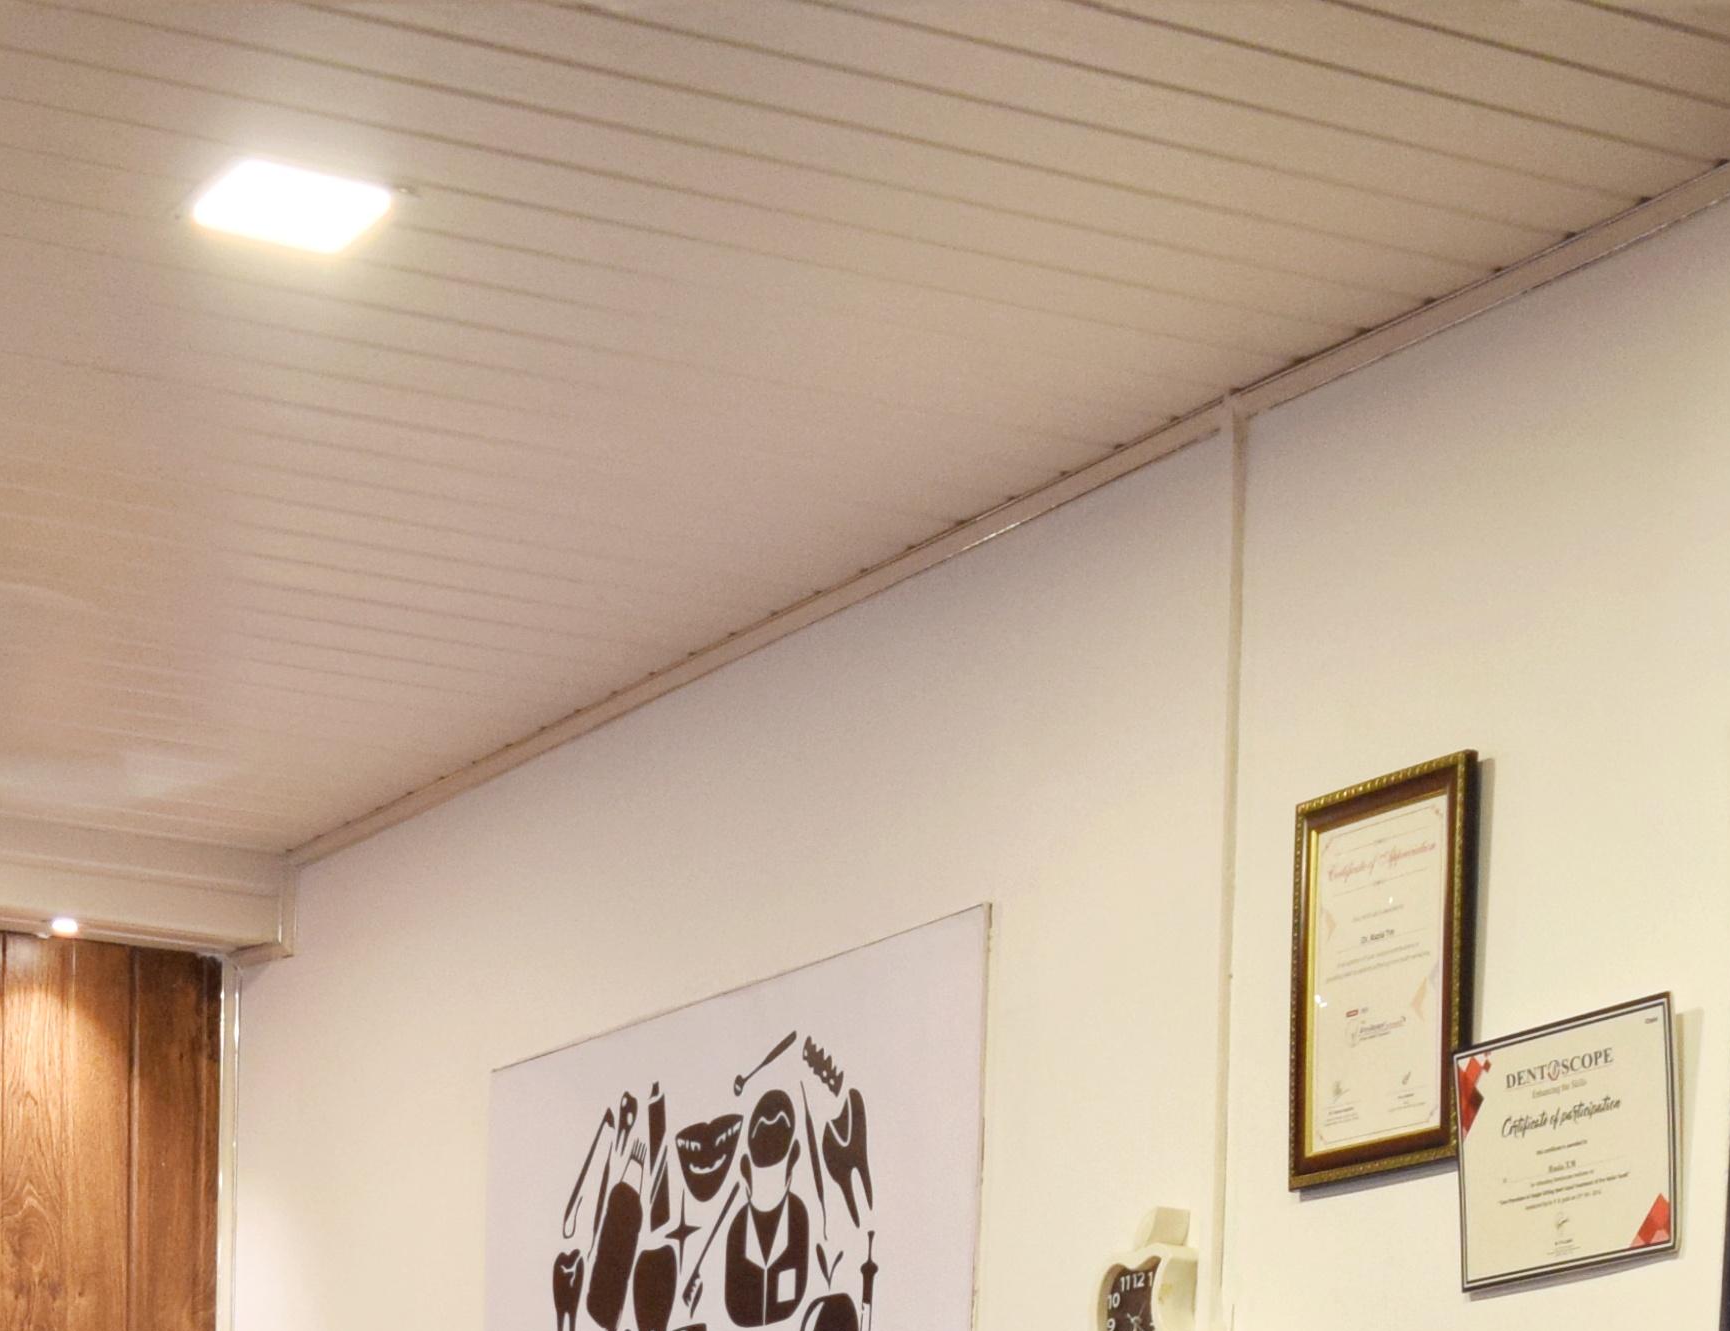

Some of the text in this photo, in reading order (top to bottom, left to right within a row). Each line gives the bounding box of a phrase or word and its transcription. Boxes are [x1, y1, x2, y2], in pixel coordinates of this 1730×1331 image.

[1120, 1277, 1131, 1292] 11
[1132, 1272, 1146, 1289] 12
[1107, 1293, 1121, 1310] 10
